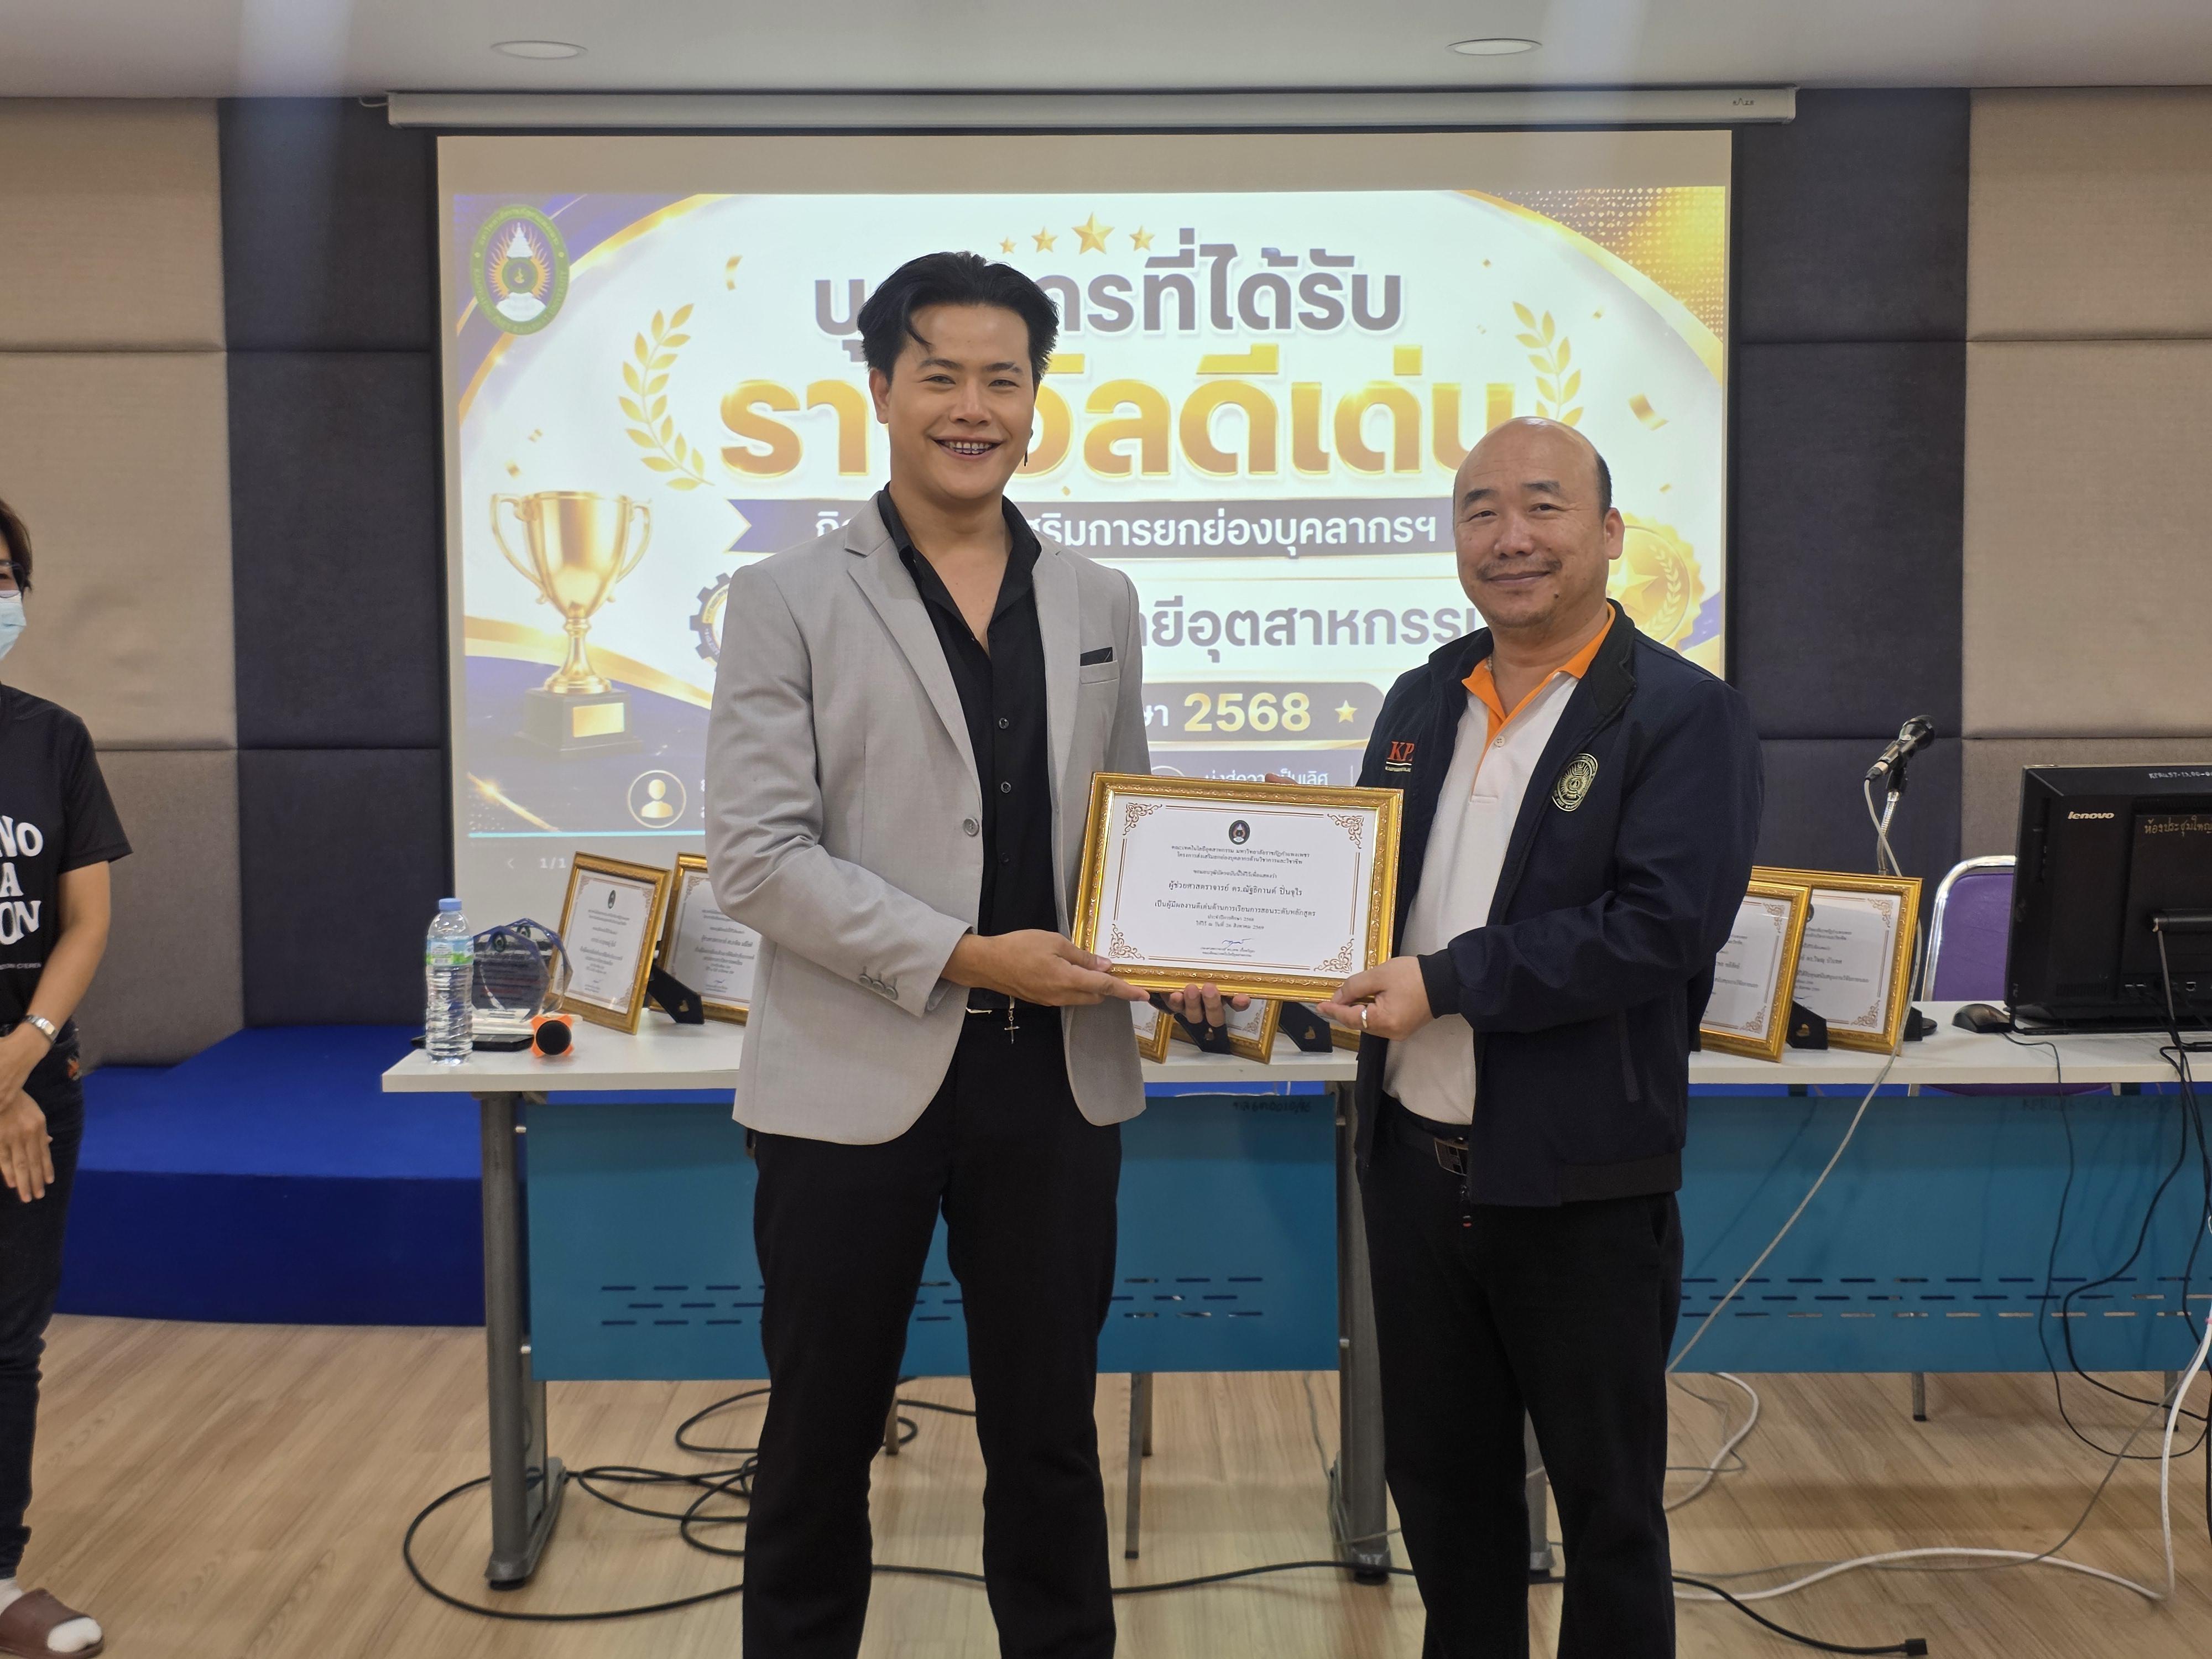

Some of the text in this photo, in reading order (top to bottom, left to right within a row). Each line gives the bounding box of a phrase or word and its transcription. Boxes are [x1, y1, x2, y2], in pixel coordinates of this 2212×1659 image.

[815, 228, 1401, 362] บุกรที่ได้รับ
[720, 345, 1515, 476] ราวัลดีเด่น
[1140, 596, 1475, 663] ยีอุตสาหกรร
[1184, 692, 1311, 732] 2568
[540, 858, 566, 869] 1/1
[1168, 880, 1229, 891] ผู้ช่วยศาสตราจารย์
